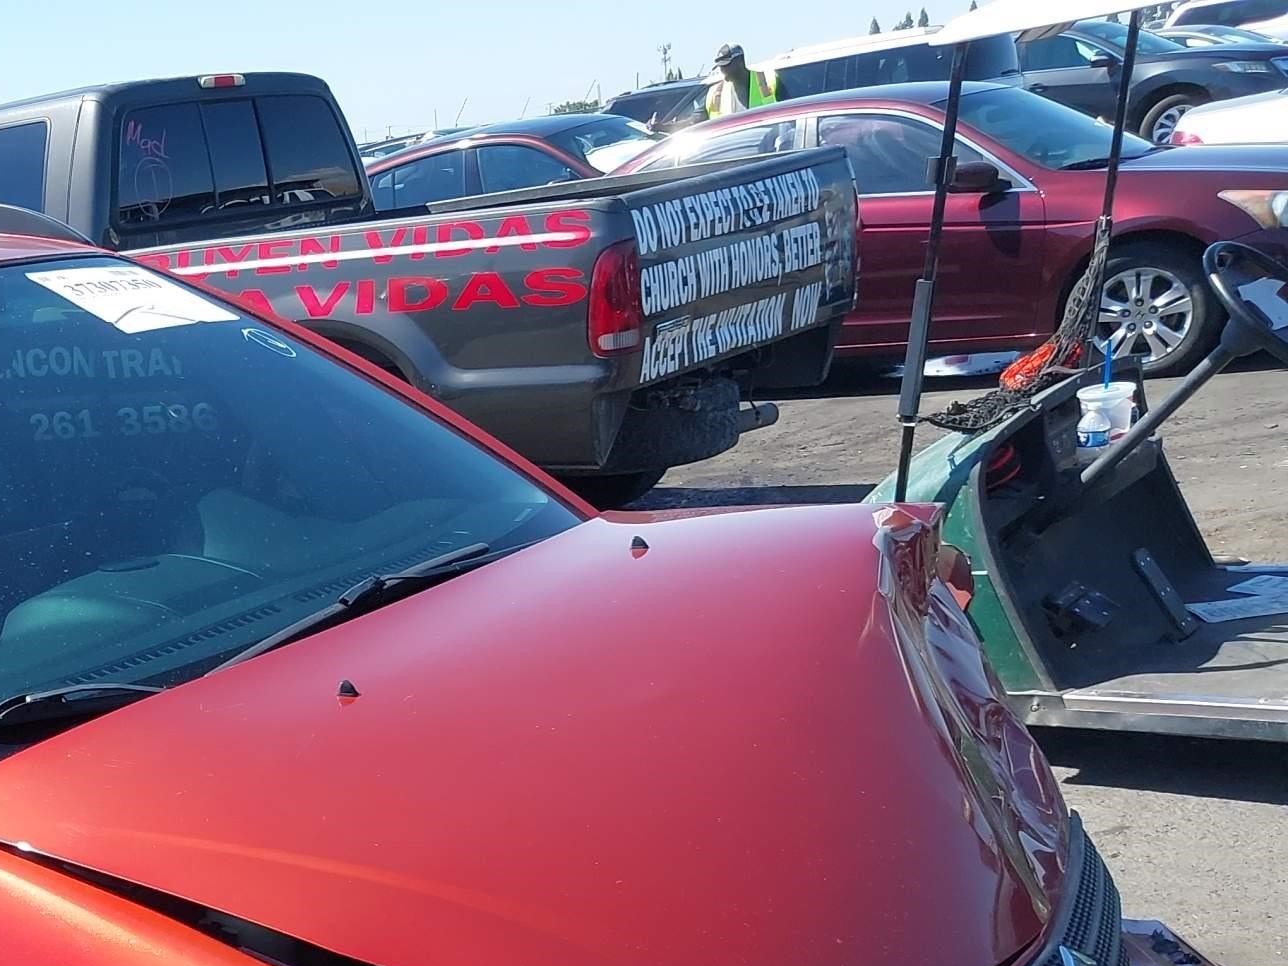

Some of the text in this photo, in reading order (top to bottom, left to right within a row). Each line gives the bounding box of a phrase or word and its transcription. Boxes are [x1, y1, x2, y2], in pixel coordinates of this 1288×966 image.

[363, 208, 593, 265] VIDAS
[631, 204, 658, 255] DO
[655, 198, 687, 248] NOT
[683, 187, 736, 243] EXPECT
[765, 171, 806, 221] TAKEN
[800, 167, 820, 211] TO
[293, 267, 590, 319] VIDAS
[640, 260, 697, 317] CHURCH
[695, 246, 730, 300] WITH
[729, 233, 783, 289] HONORS,
[783, 221, 822, 273] BETTER
[639, 325, 691, 384] ACCEPT
[690, 316, 716, 364] THE
[790, 281, 824, 332] NOW
[29, 408, 100, 440] 261
